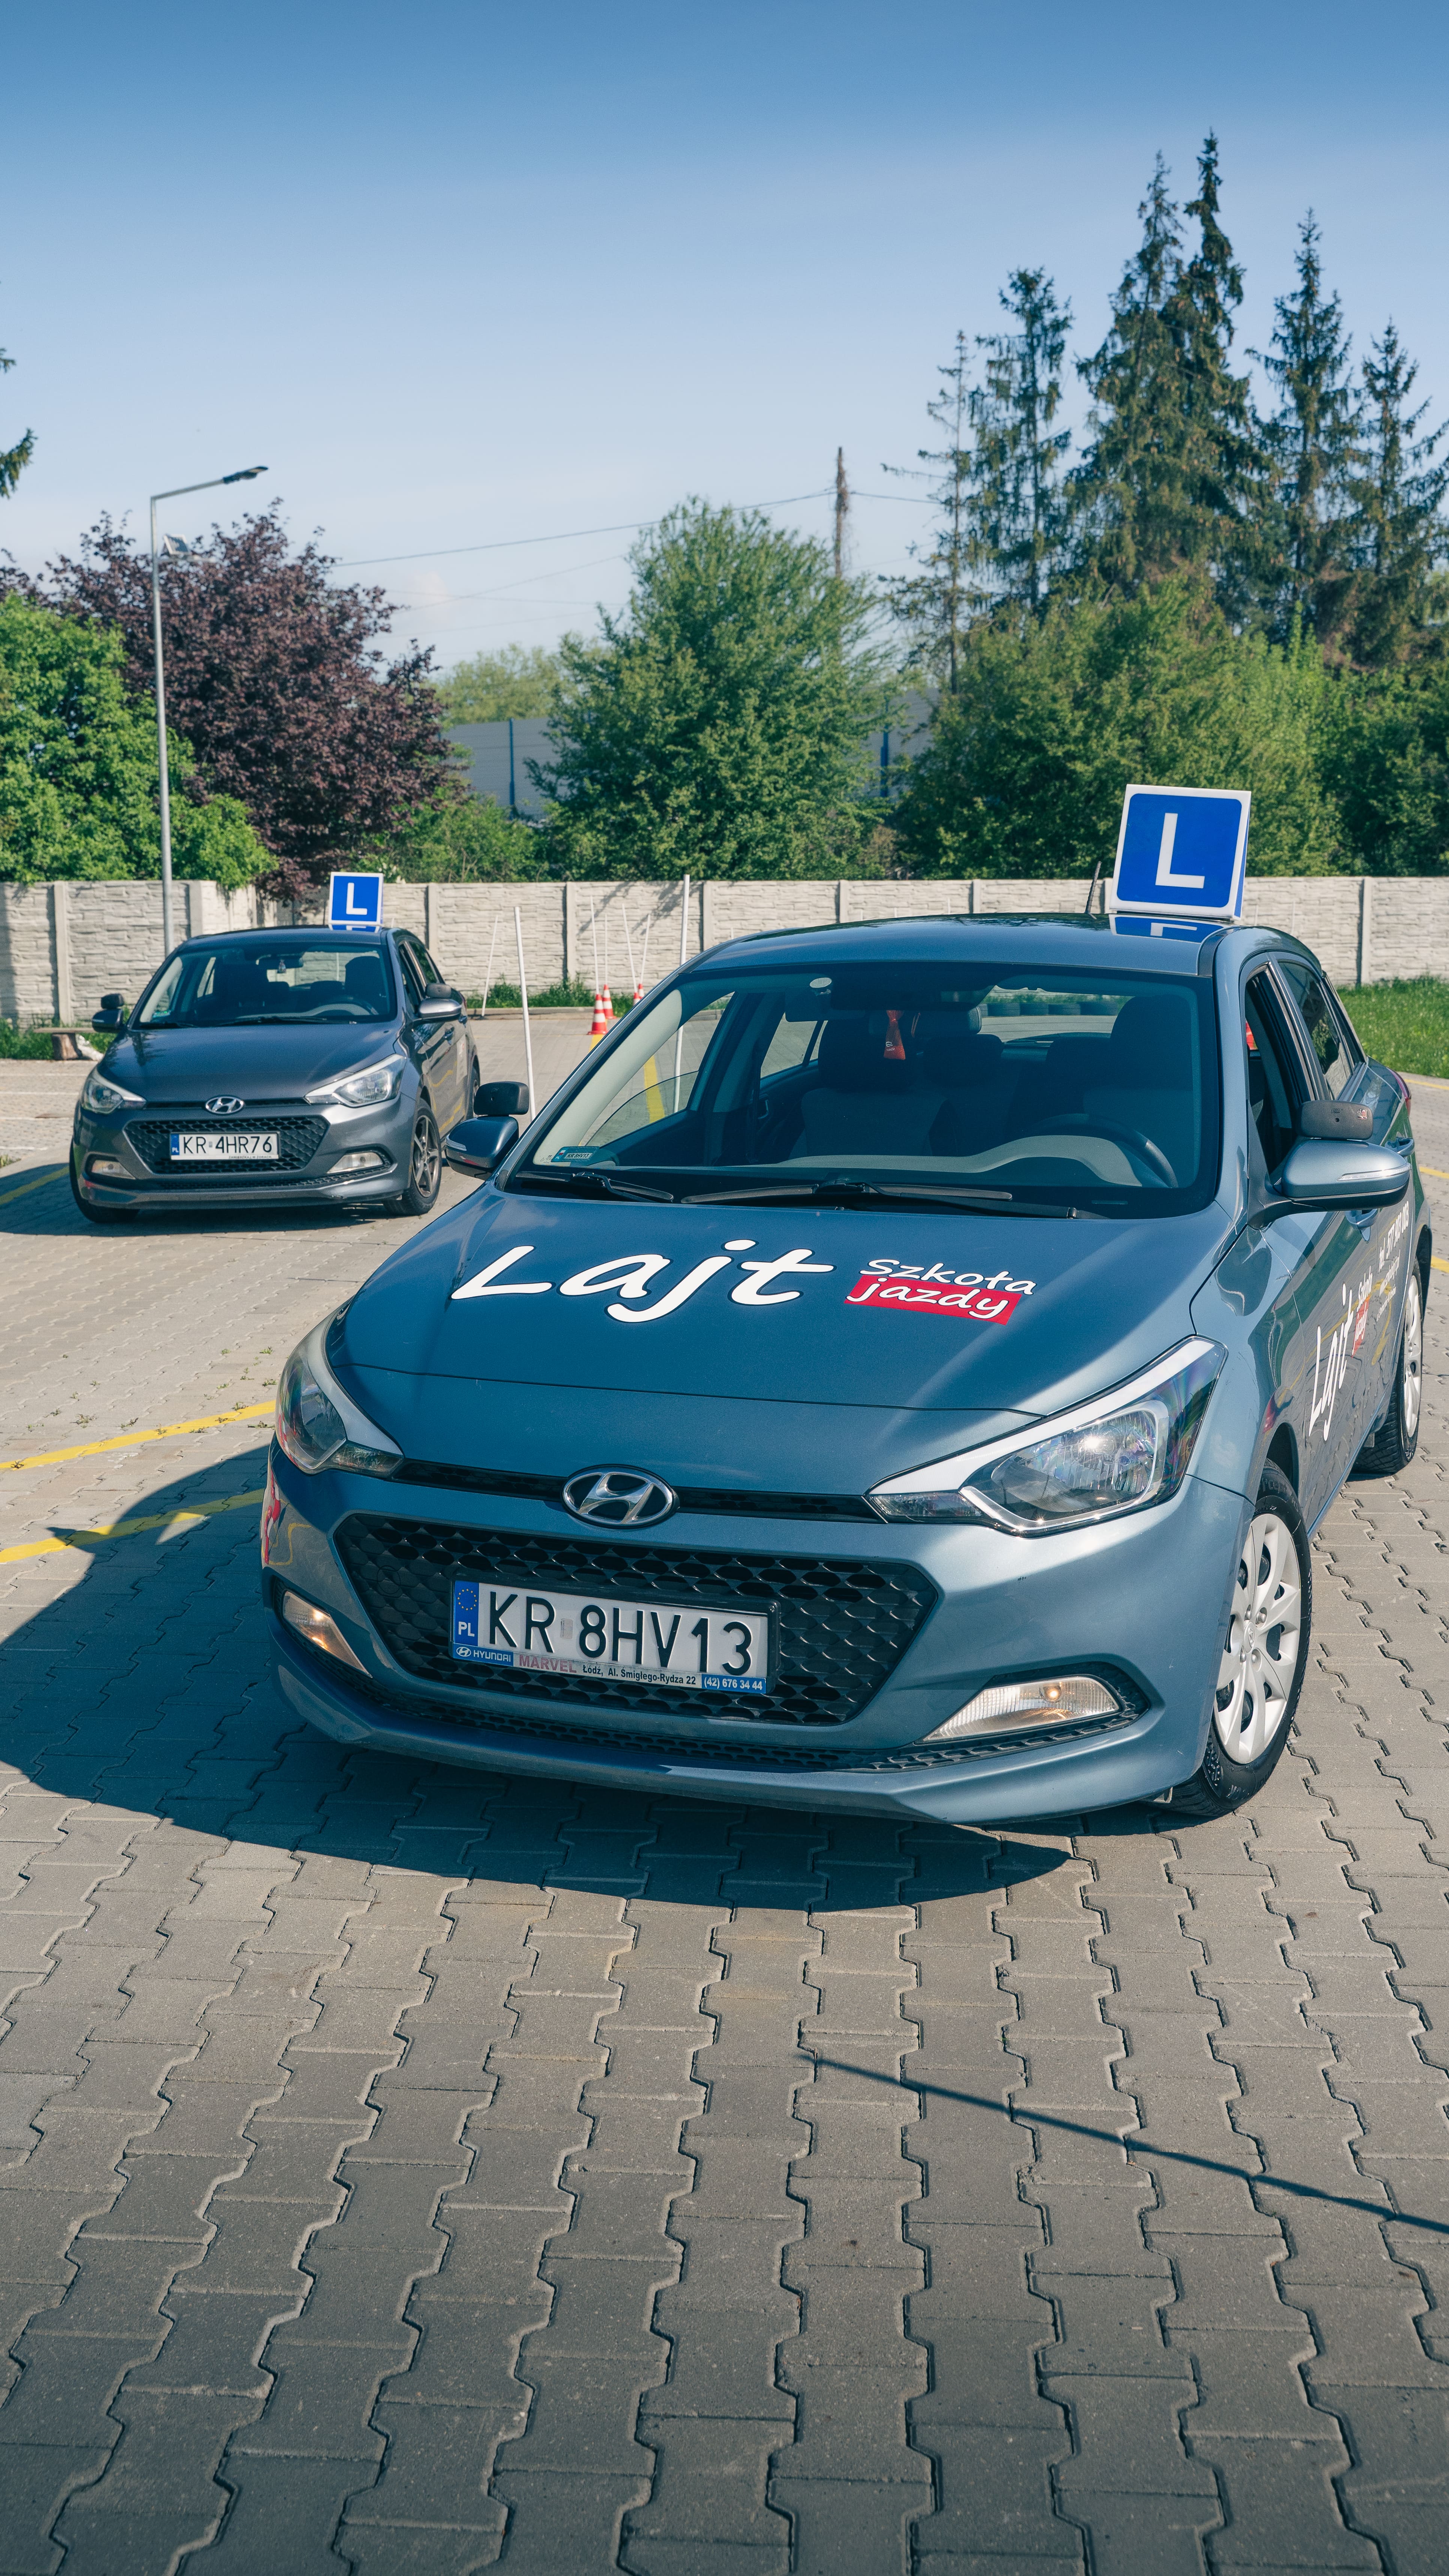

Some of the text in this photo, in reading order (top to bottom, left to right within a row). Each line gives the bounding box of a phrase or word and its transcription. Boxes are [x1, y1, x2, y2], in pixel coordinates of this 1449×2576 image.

[1155, 812, 1205, 889] L
[346, 882, 368, 915] L
[183, 1136, 272, 1154] KR 4HR76
[1386, 1223, 1395, 1260] 577
[451, 1239, 834, 1323] Lajt
[860, 1259, 1036, 1295] Szkoła
[846, 1277, 1009, 1319] jazdy
[1352, 1302, 1368, 1356] jazdy
[1308, 1283, 1353, 1441] Lajt
[458, 1621, 475, 1637] PL
[489, 1591, 752, 1676] KR 8HV13
[473, 1650, 511, 1663] HYUNDAI
[519, 1655, 577, 1673] MARVEL
[582, 1664, 696, 1686] Łódź, Al. Śmigłego-Rydza 22
[704, 1677, 763, 1690] (42) 676 34 44
